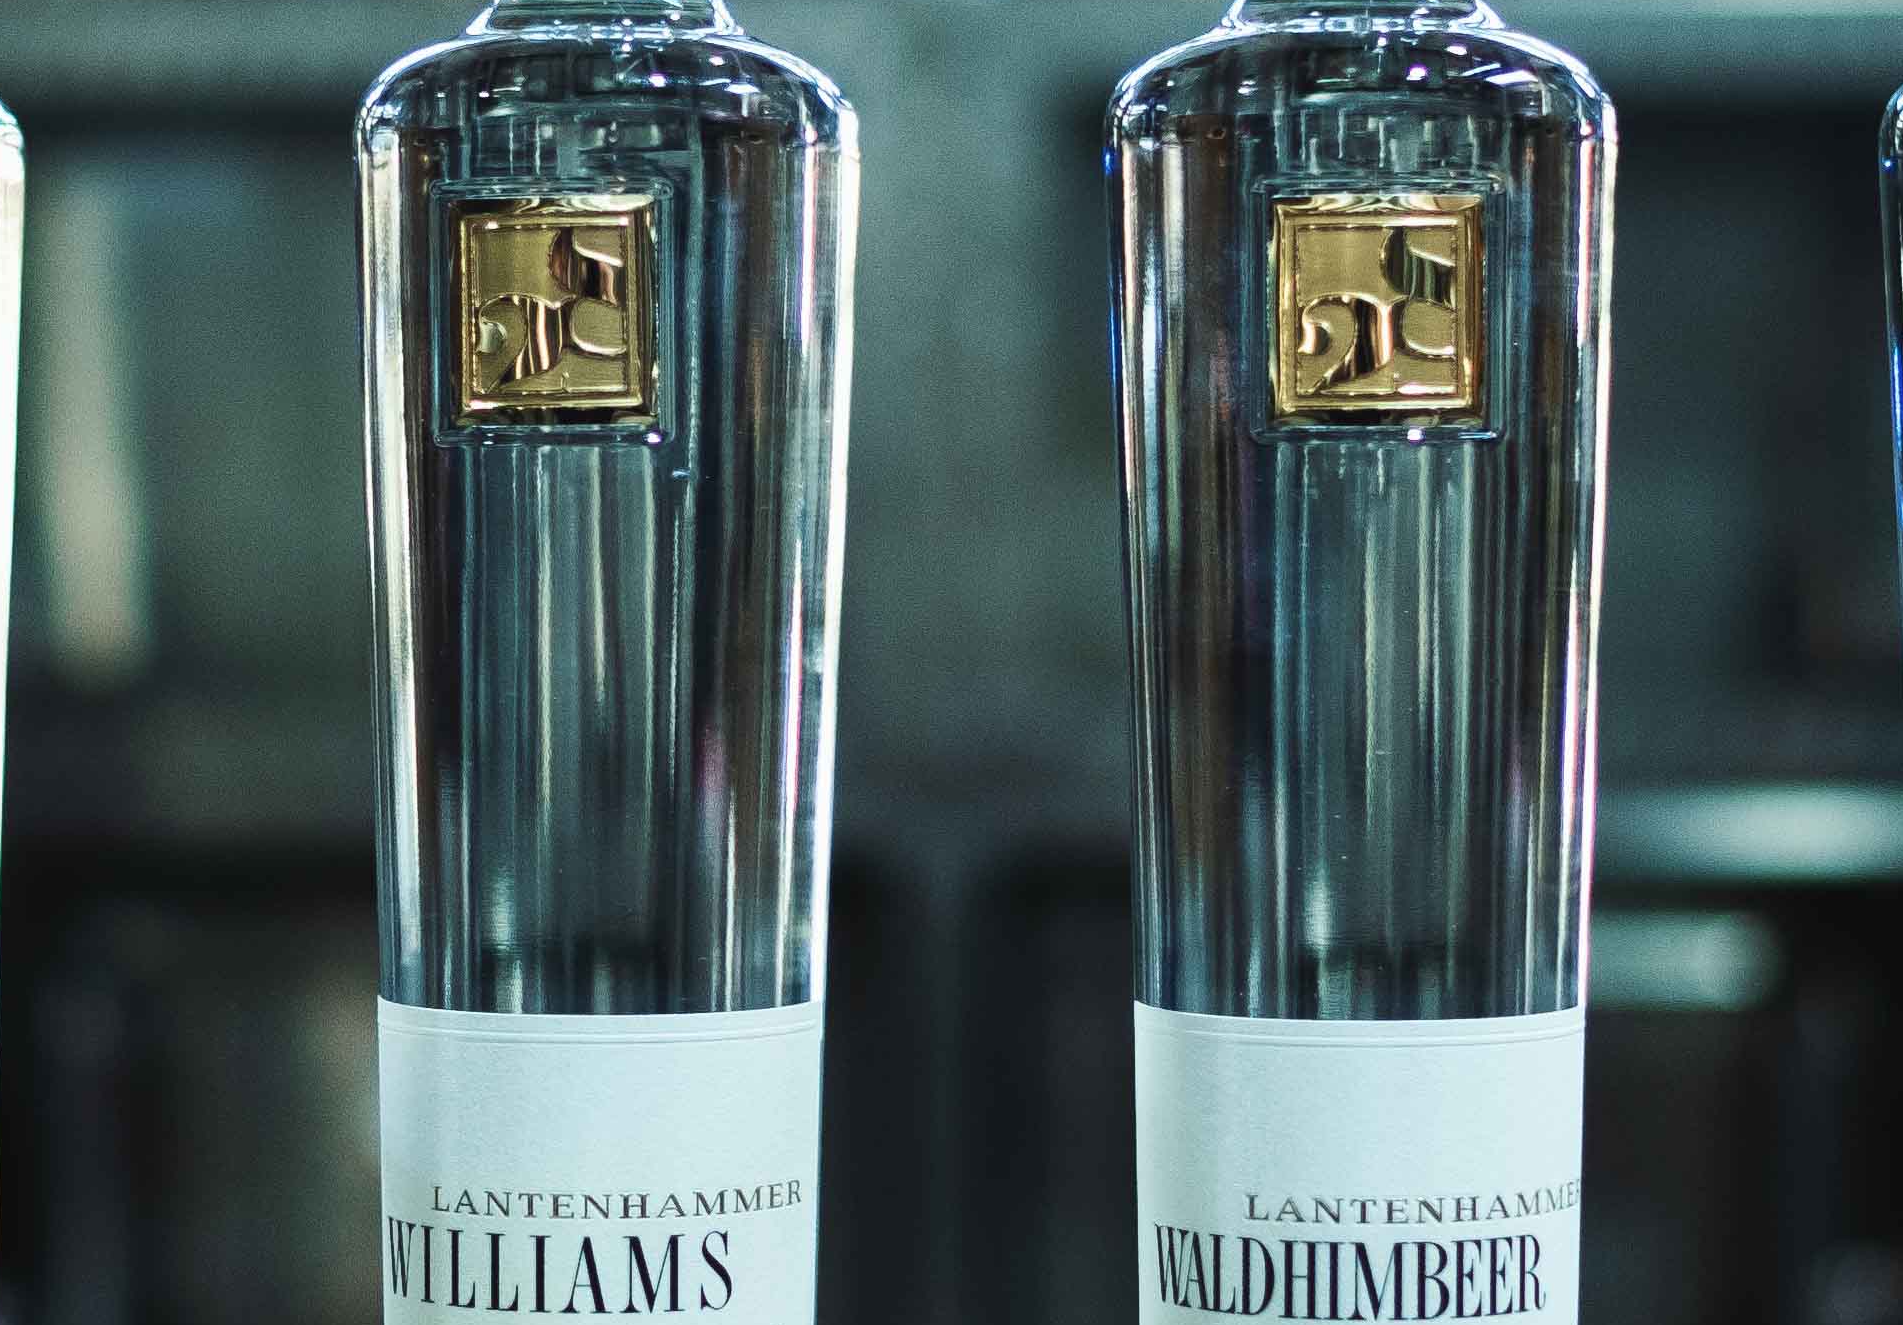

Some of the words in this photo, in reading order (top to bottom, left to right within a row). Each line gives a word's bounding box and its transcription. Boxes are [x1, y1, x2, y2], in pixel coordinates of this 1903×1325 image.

[433, 1179, 801, 1219] LANTENHAMMER
[387, 1216, 733, 1314] WILLIAMS
[1154, 1221, 1546, 1322] WALDHIMBEER
